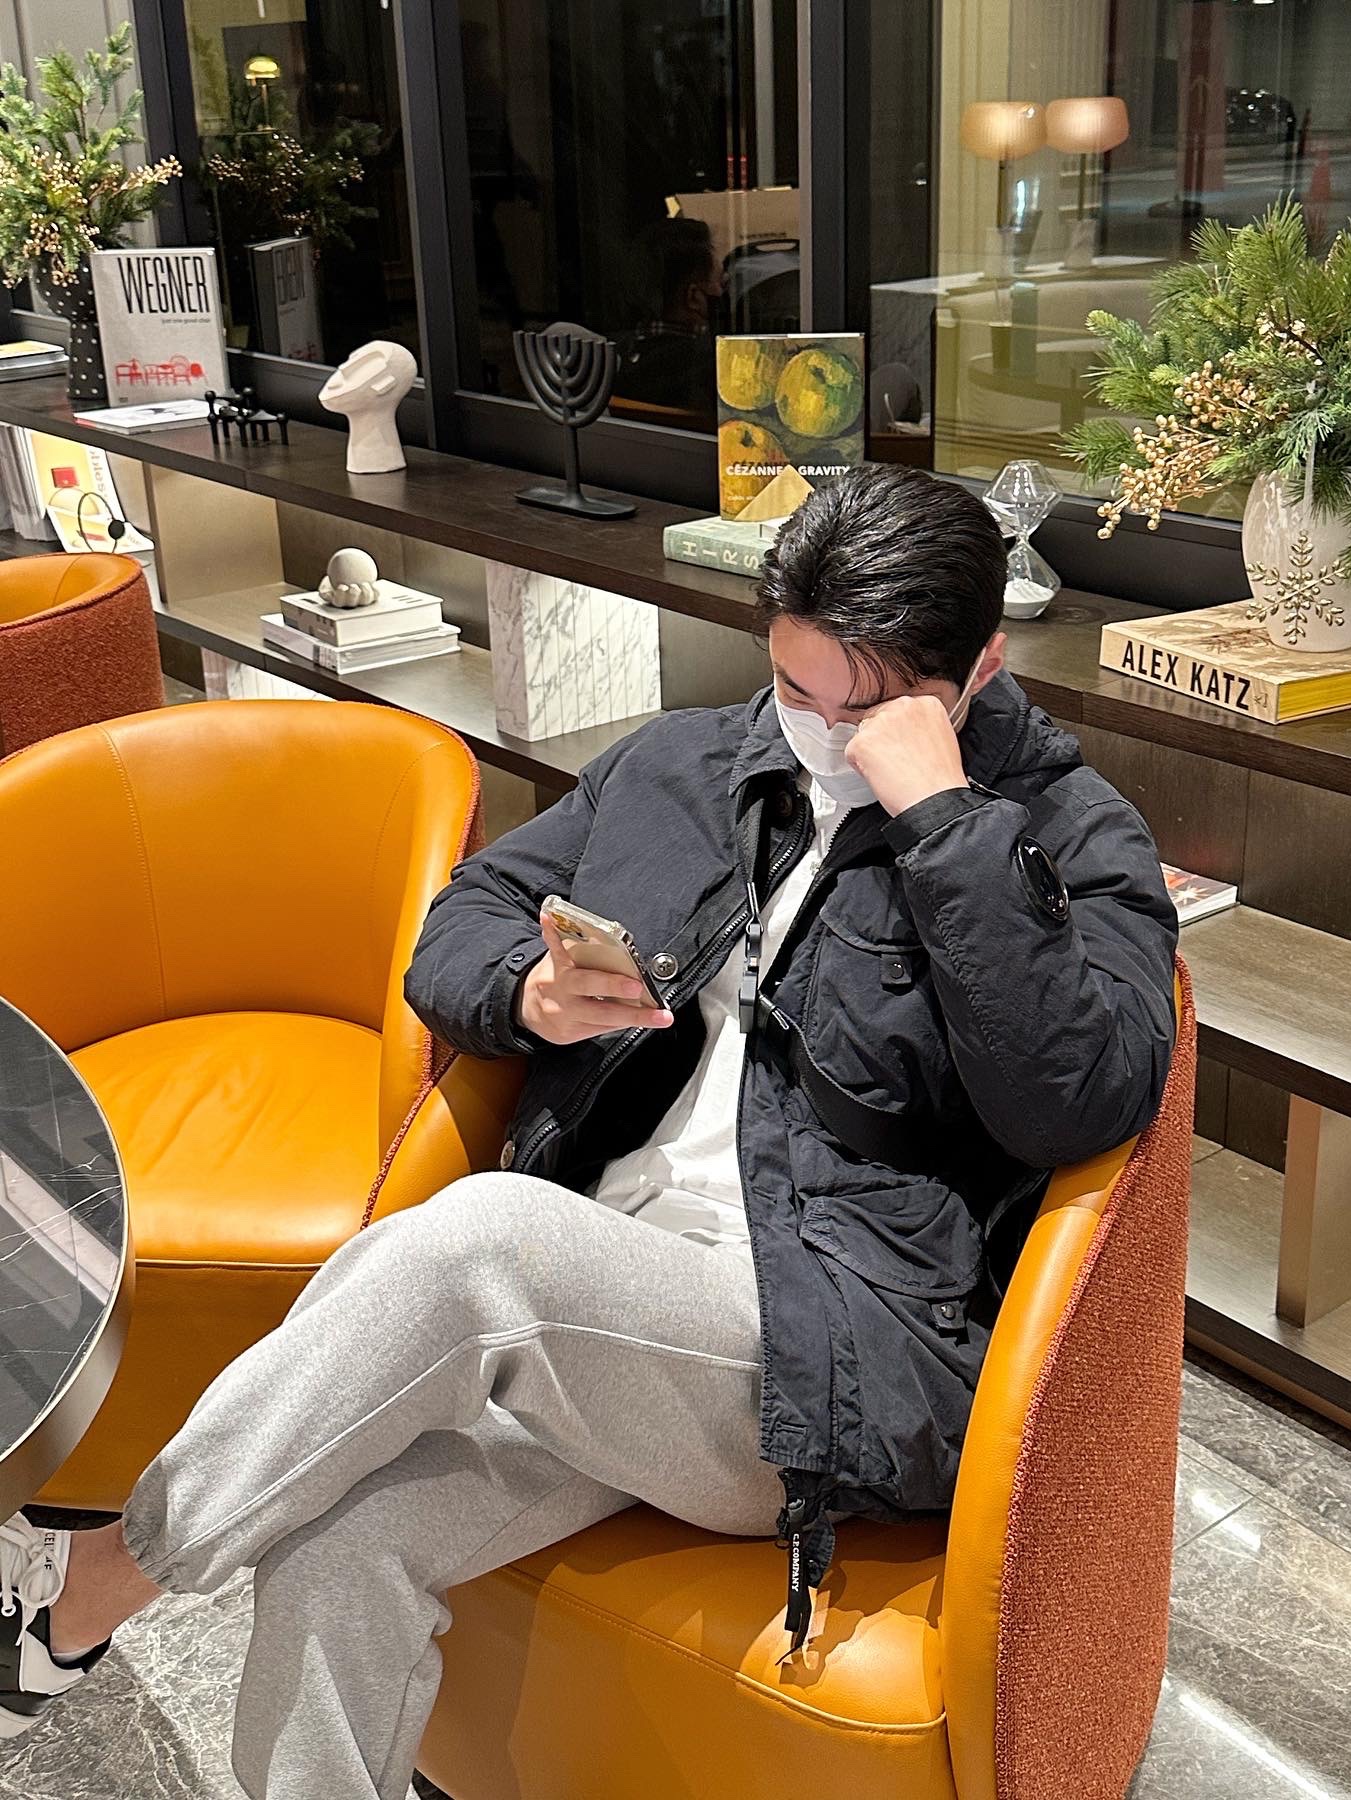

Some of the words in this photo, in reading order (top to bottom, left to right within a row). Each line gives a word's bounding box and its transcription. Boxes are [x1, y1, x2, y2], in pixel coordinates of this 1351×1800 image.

[117, 256, 210, 313] WEGNER
[798, 466, 850, 476] GRAVITY
[1121, 640, 1179, 686] ALEX
[1190, 662, 1251, 711] KATZ
